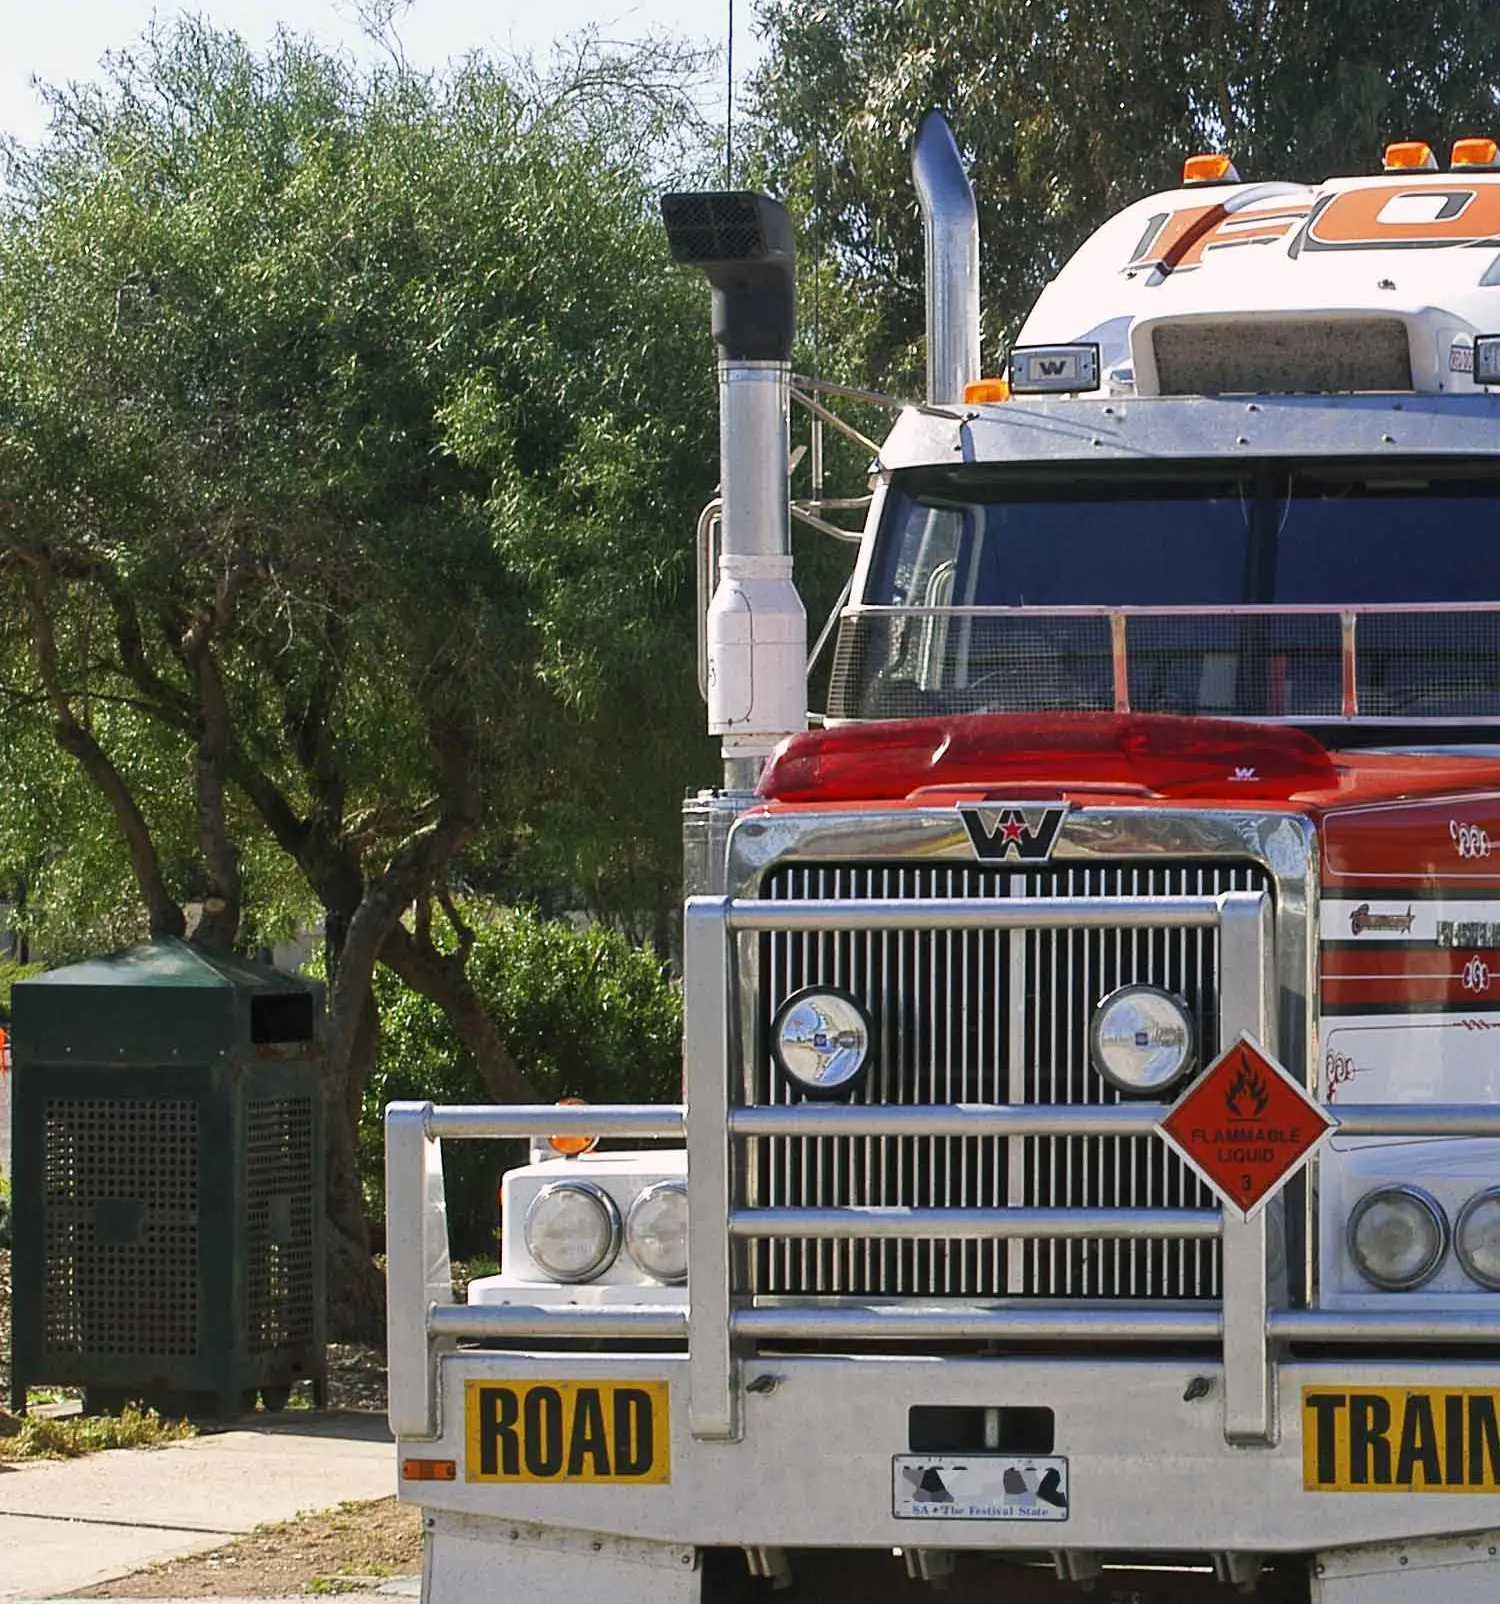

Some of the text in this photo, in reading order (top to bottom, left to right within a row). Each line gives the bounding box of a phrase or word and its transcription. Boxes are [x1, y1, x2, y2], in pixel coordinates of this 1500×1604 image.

[1191, 1128, 1301, 1144] FLAMMABLE
[1218, 1148, 1275, 1164] LIQUID
[1240, 1174, 1254, 1192] 3
[479, 1386, 654, 1477] ROAD
[940, 1504, 965, 1516] The
[968, 1504, 1014, 1517] Festival
[1018, 1505, 1049, 1516] State
